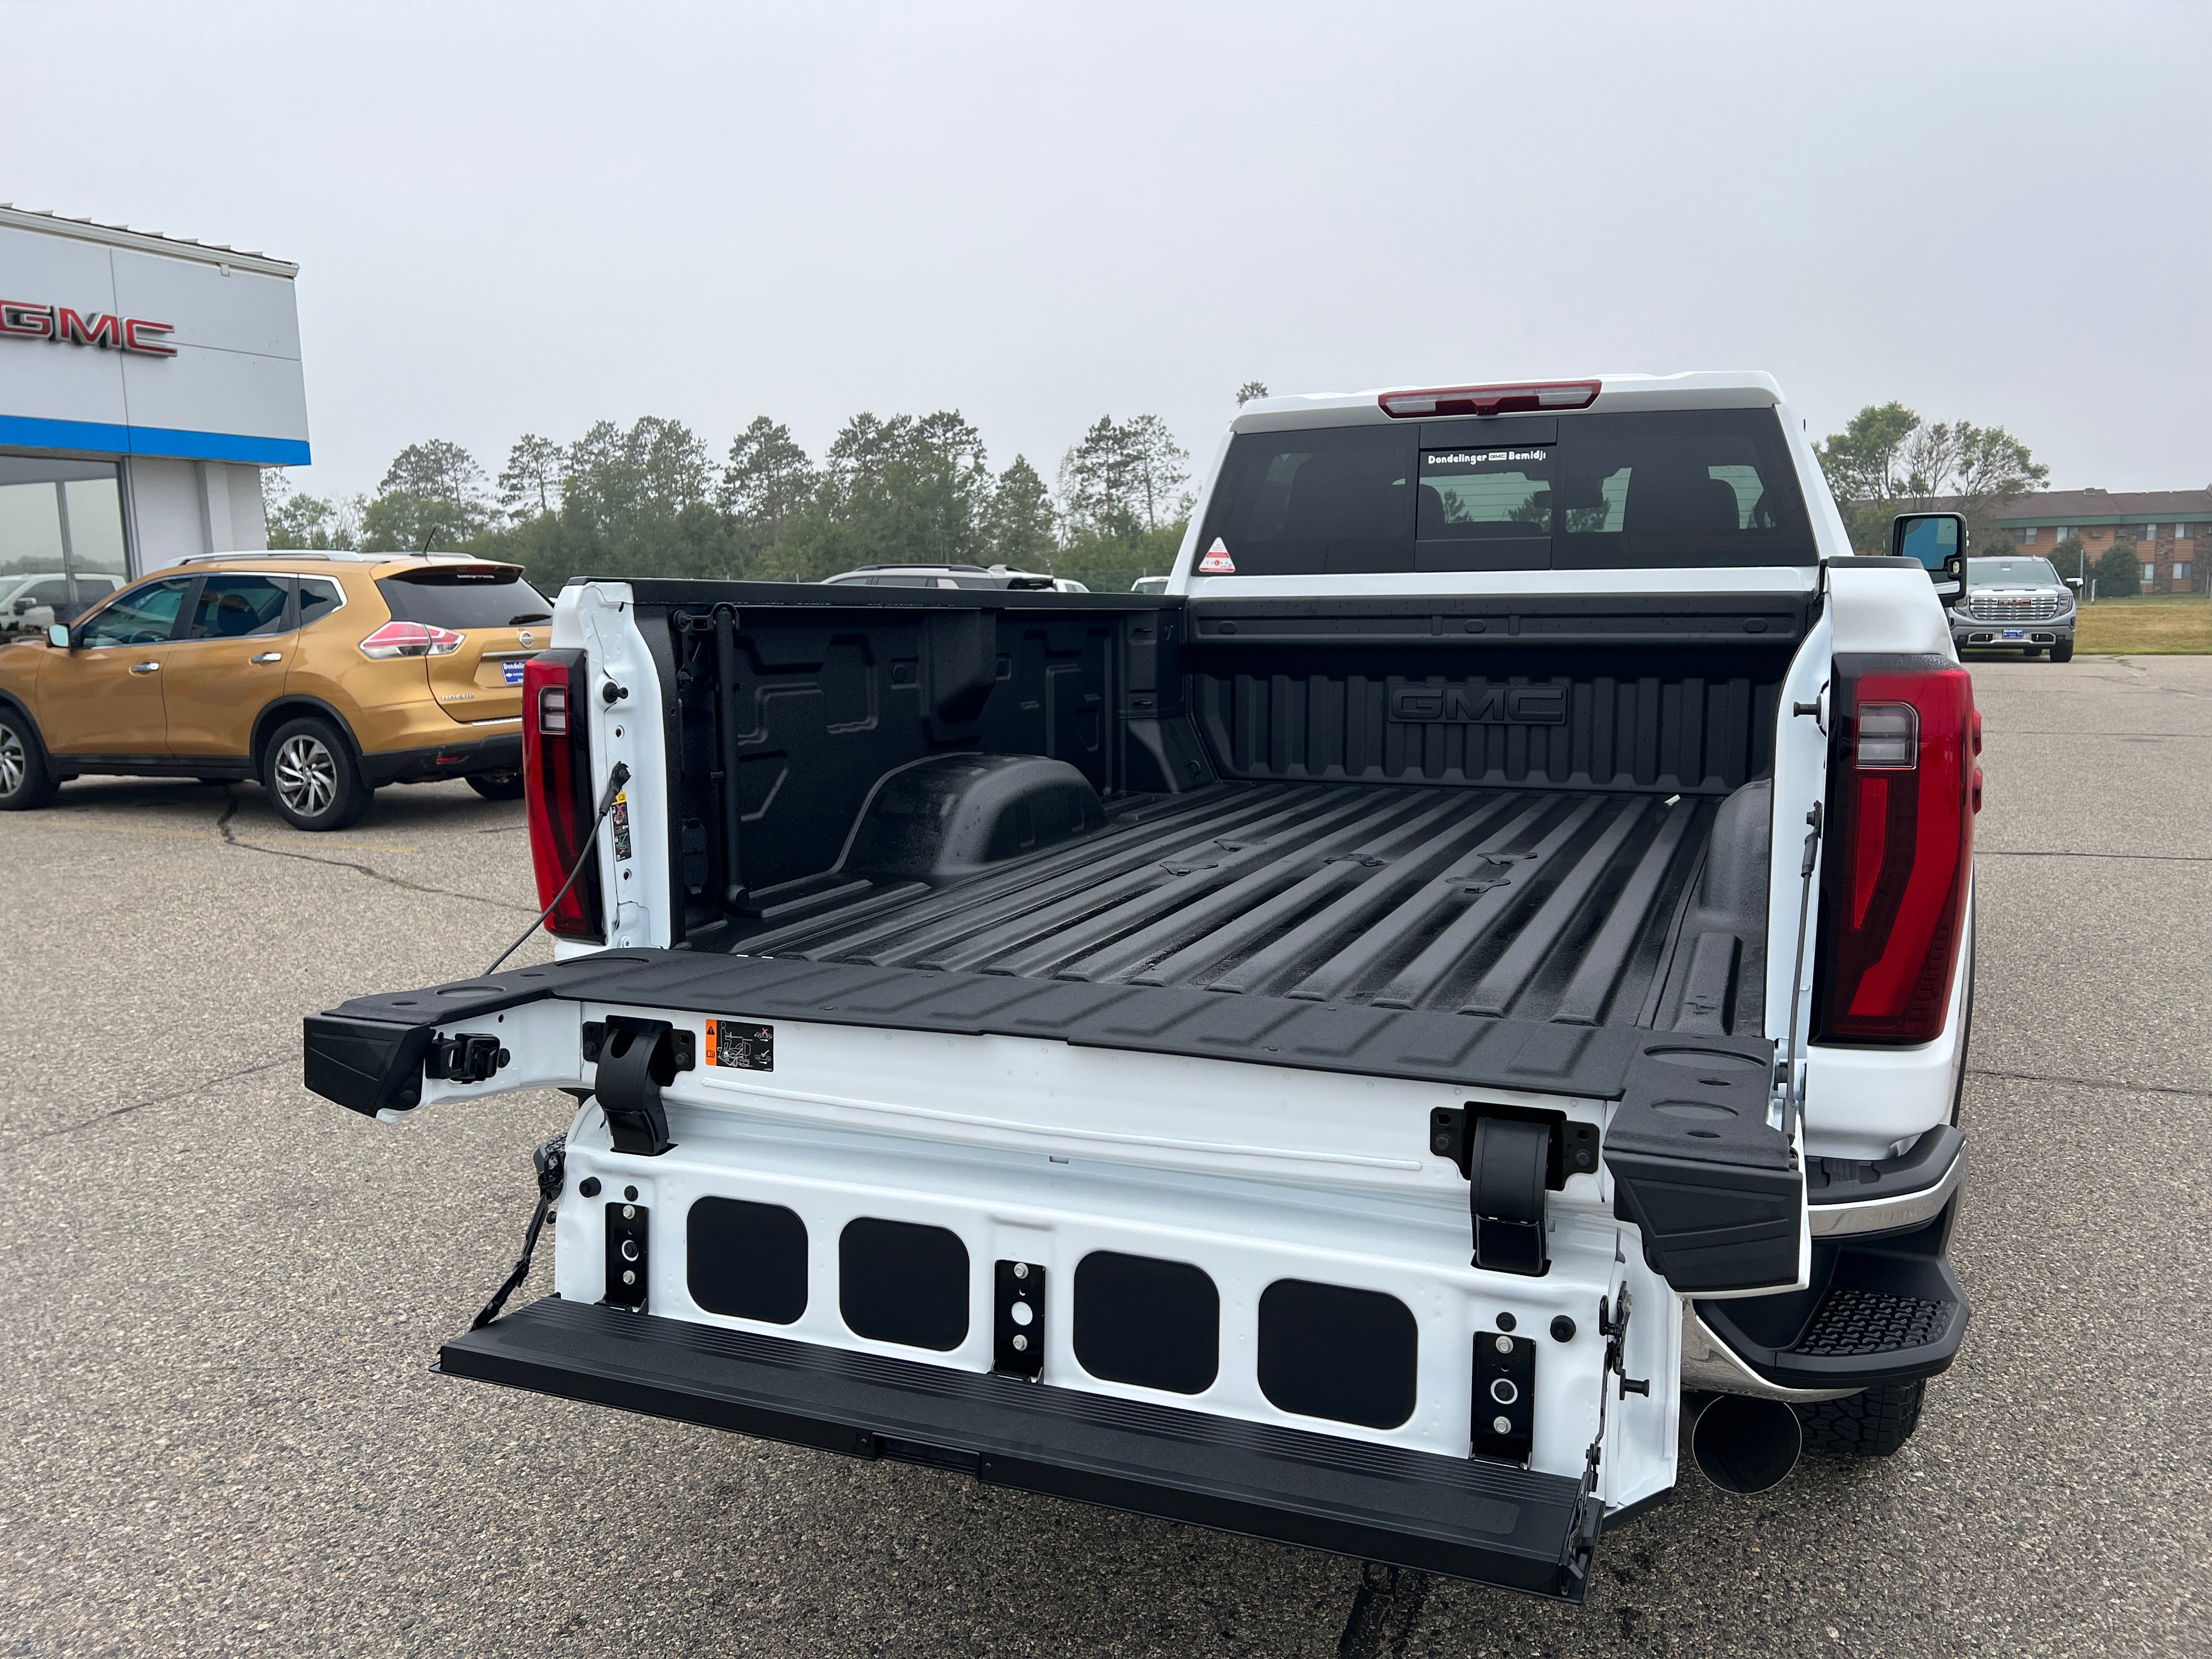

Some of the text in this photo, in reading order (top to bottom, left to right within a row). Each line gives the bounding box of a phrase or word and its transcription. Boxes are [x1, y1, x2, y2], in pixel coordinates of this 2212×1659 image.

[0, 300, 177, 357] GMC
[1428, 453, 1487, 465] Dondelinger
[1391, 688, 1563, 721] GMC
